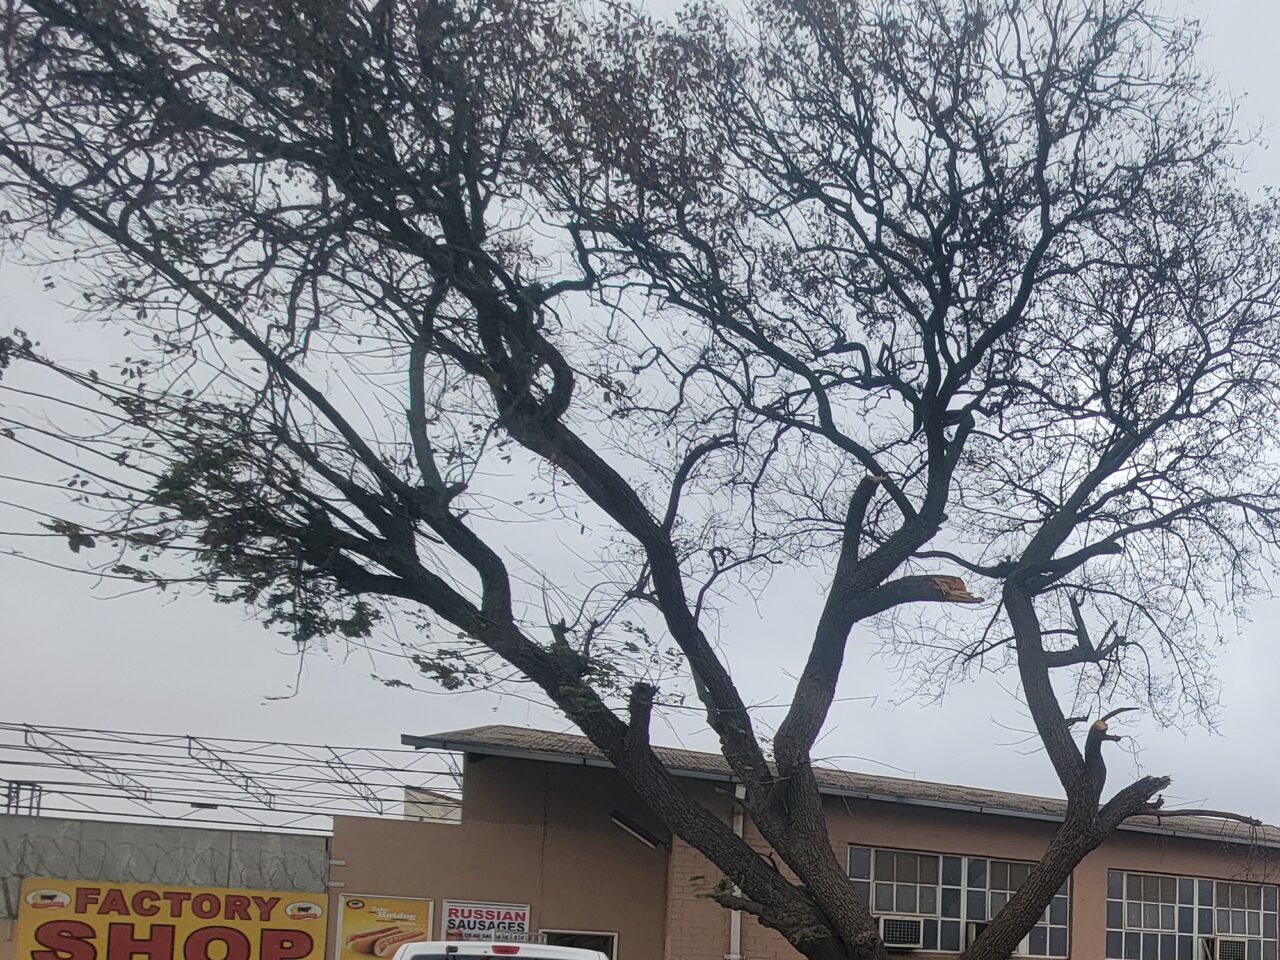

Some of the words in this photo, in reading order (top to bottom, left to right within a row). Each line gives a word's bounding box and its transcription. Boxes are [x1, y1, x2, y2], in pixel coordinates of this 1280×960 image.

[75, 887, 281, 921] FACTORY
[448, 908, 526, 922] RUSSIAN
[447, 919, 525, 932] SAUSAGES
